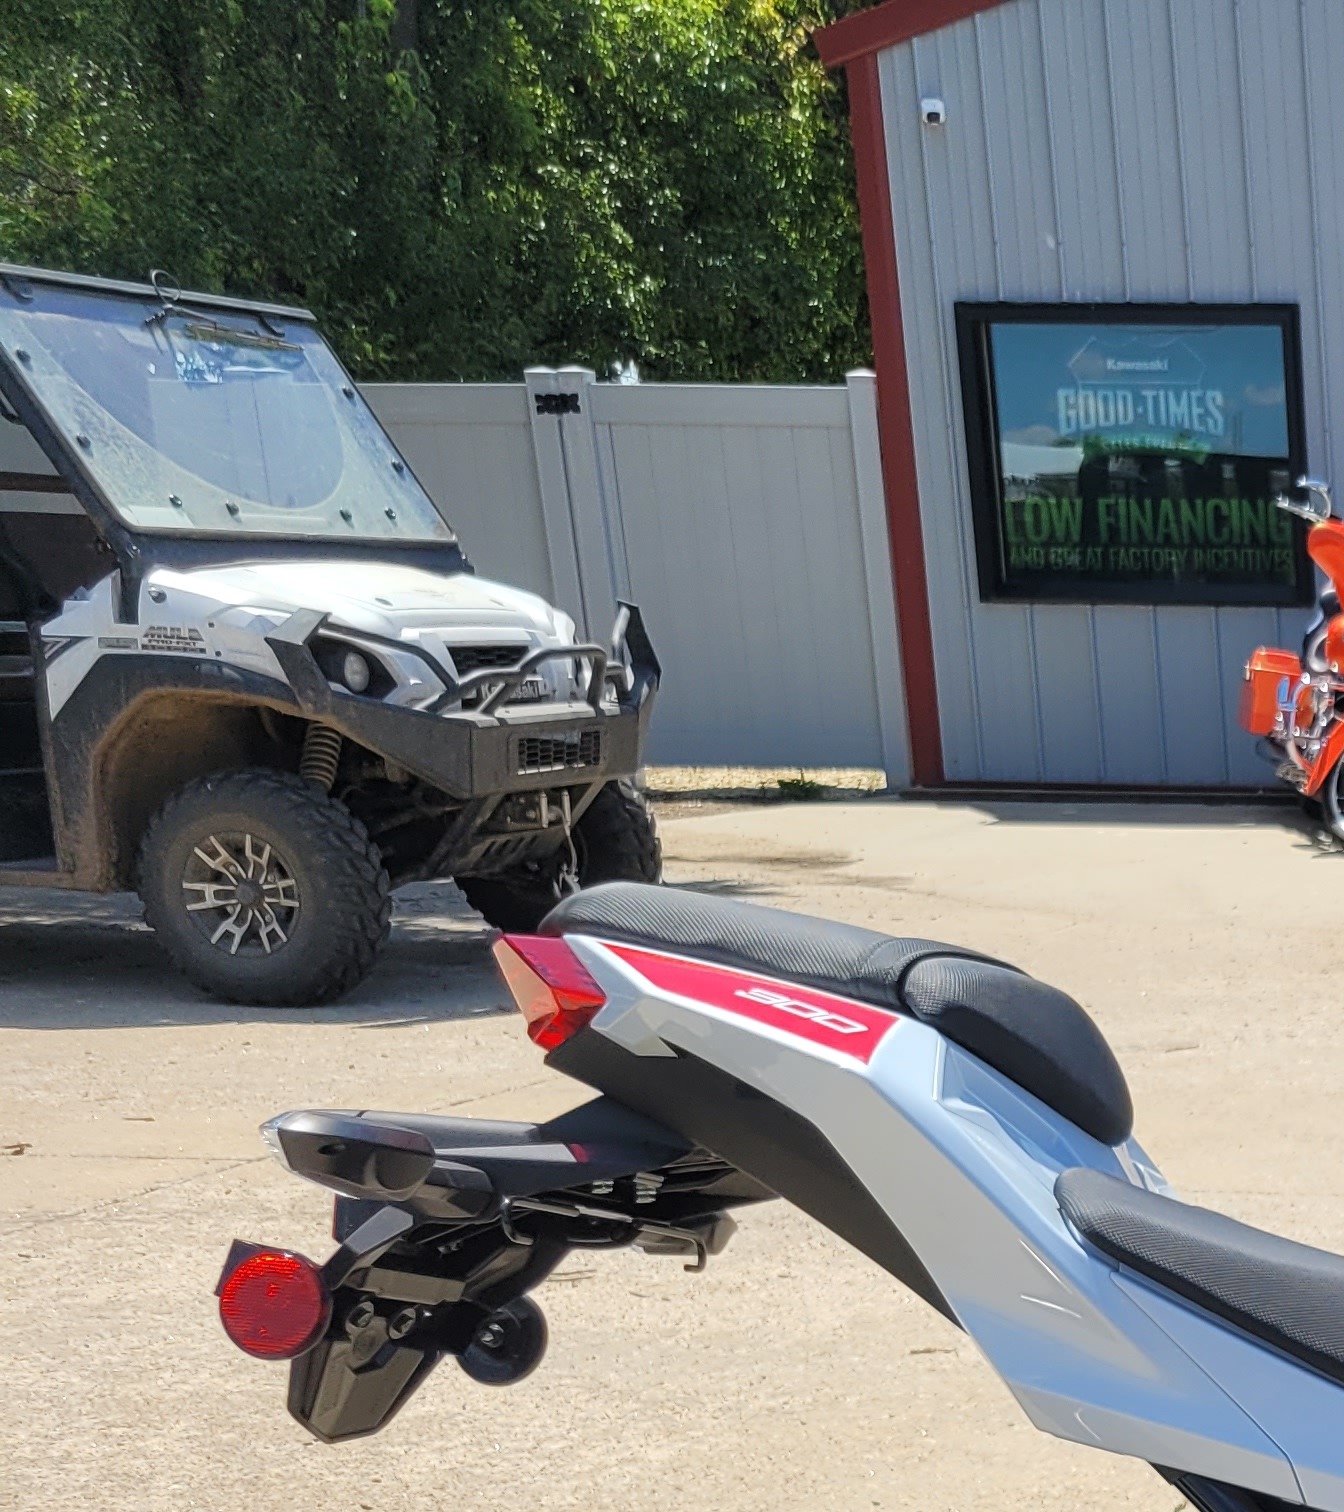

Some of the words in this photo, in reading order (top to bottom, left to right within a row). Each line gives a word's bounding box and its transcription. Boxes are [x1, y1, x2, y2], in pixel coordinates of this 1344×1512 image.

[1106, 359, 1168, 371] Kawasaki
[1004, 496, 1083, 543] LOW
[1100, 496, 1292, 545] FINANCING
[733, 987, 868, 1034] 300
